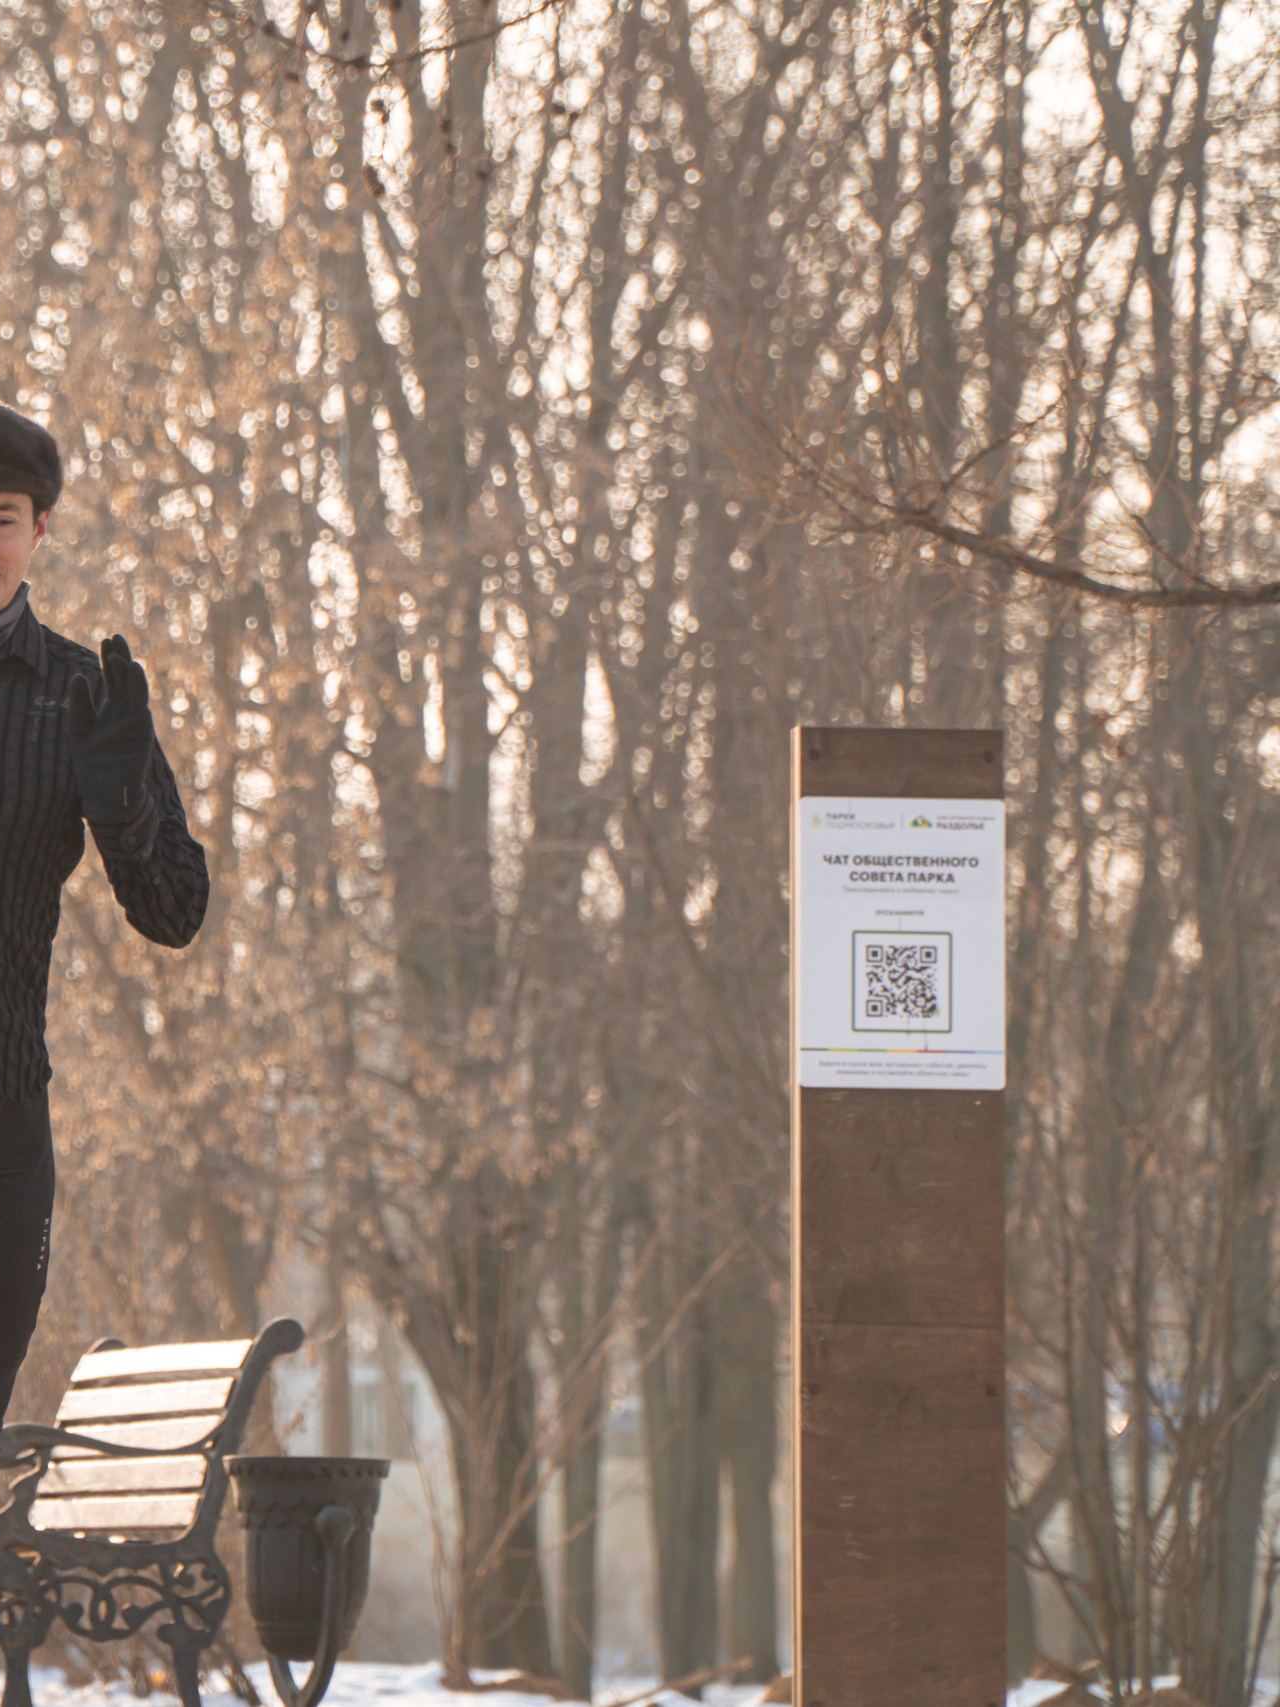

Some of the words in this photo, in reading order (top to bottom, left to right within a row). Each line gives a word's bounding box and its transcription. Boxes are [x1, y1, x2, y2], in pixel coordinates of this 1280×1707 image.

[825, 812, 855, 821] ПАРКИ
[936, 822, 984, 831] РАЗДОЛЬЕ
[823, 855, 849, 865] ЧАТ
[853, 855, 979, 868] ОБЩЕСТВЕННОГО
[849, 871, 904, 882] СОВЕТА
[907, 872, 955, 883] ПАРКА
